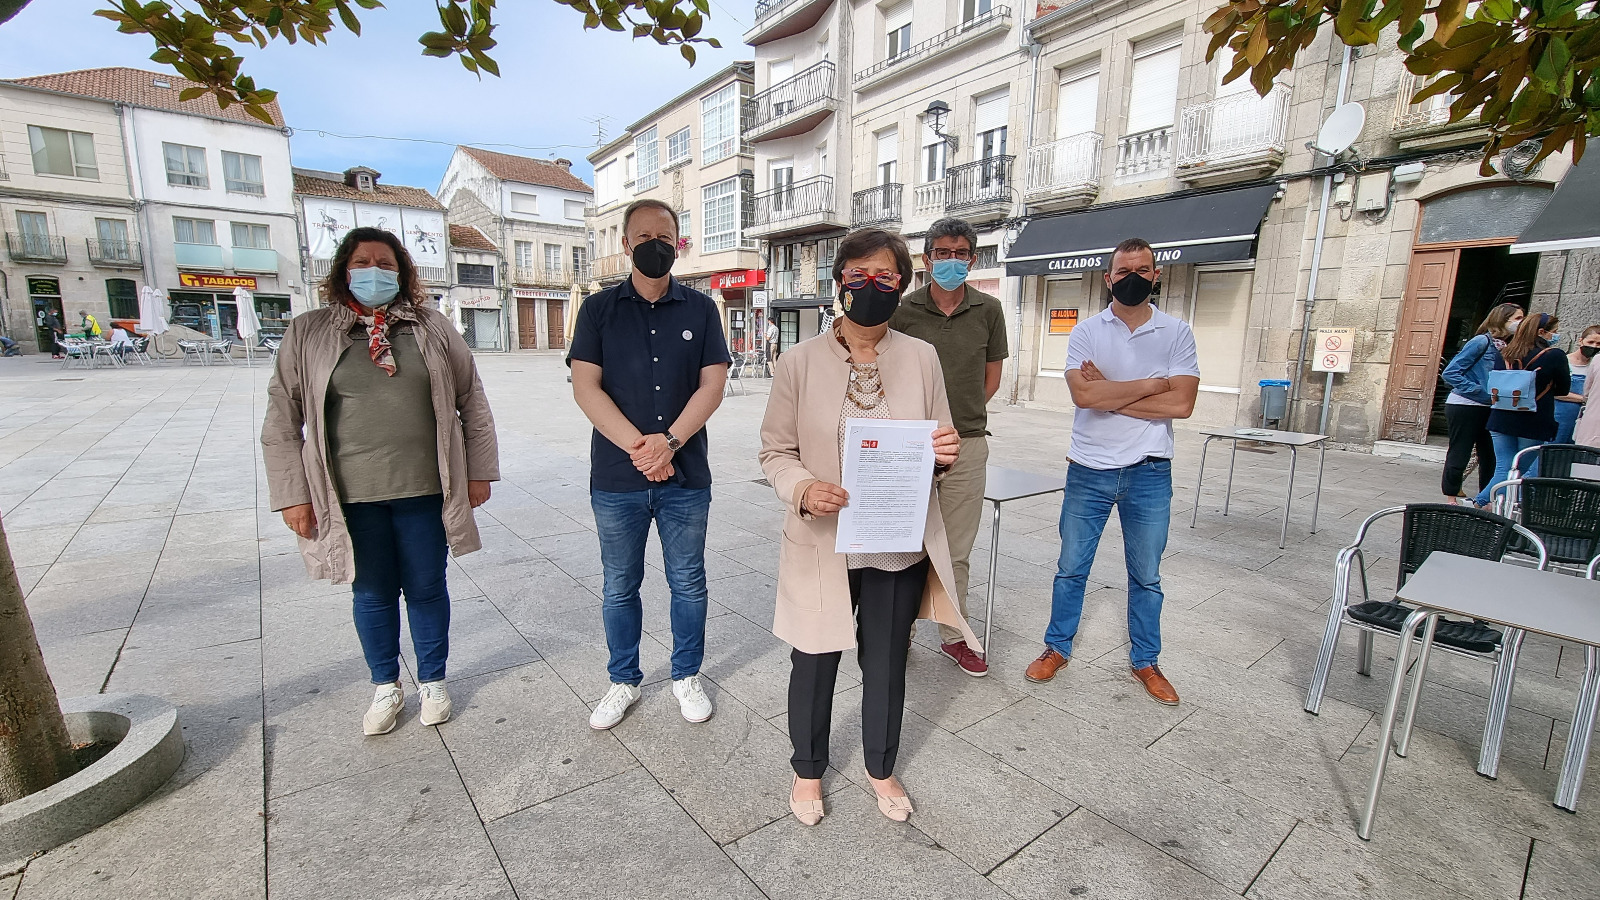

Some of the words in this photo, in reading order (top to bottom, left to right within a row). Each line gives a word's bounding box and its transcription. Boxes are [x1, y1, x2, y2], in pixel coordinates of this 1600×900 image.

[1048, 256, 1102, 270] CALZADOS
[201, 276, 256, 287] TABACOS
[1050, 310, 1058, 318] SE
[1058, 309, 1077, 318] ALQUILA
